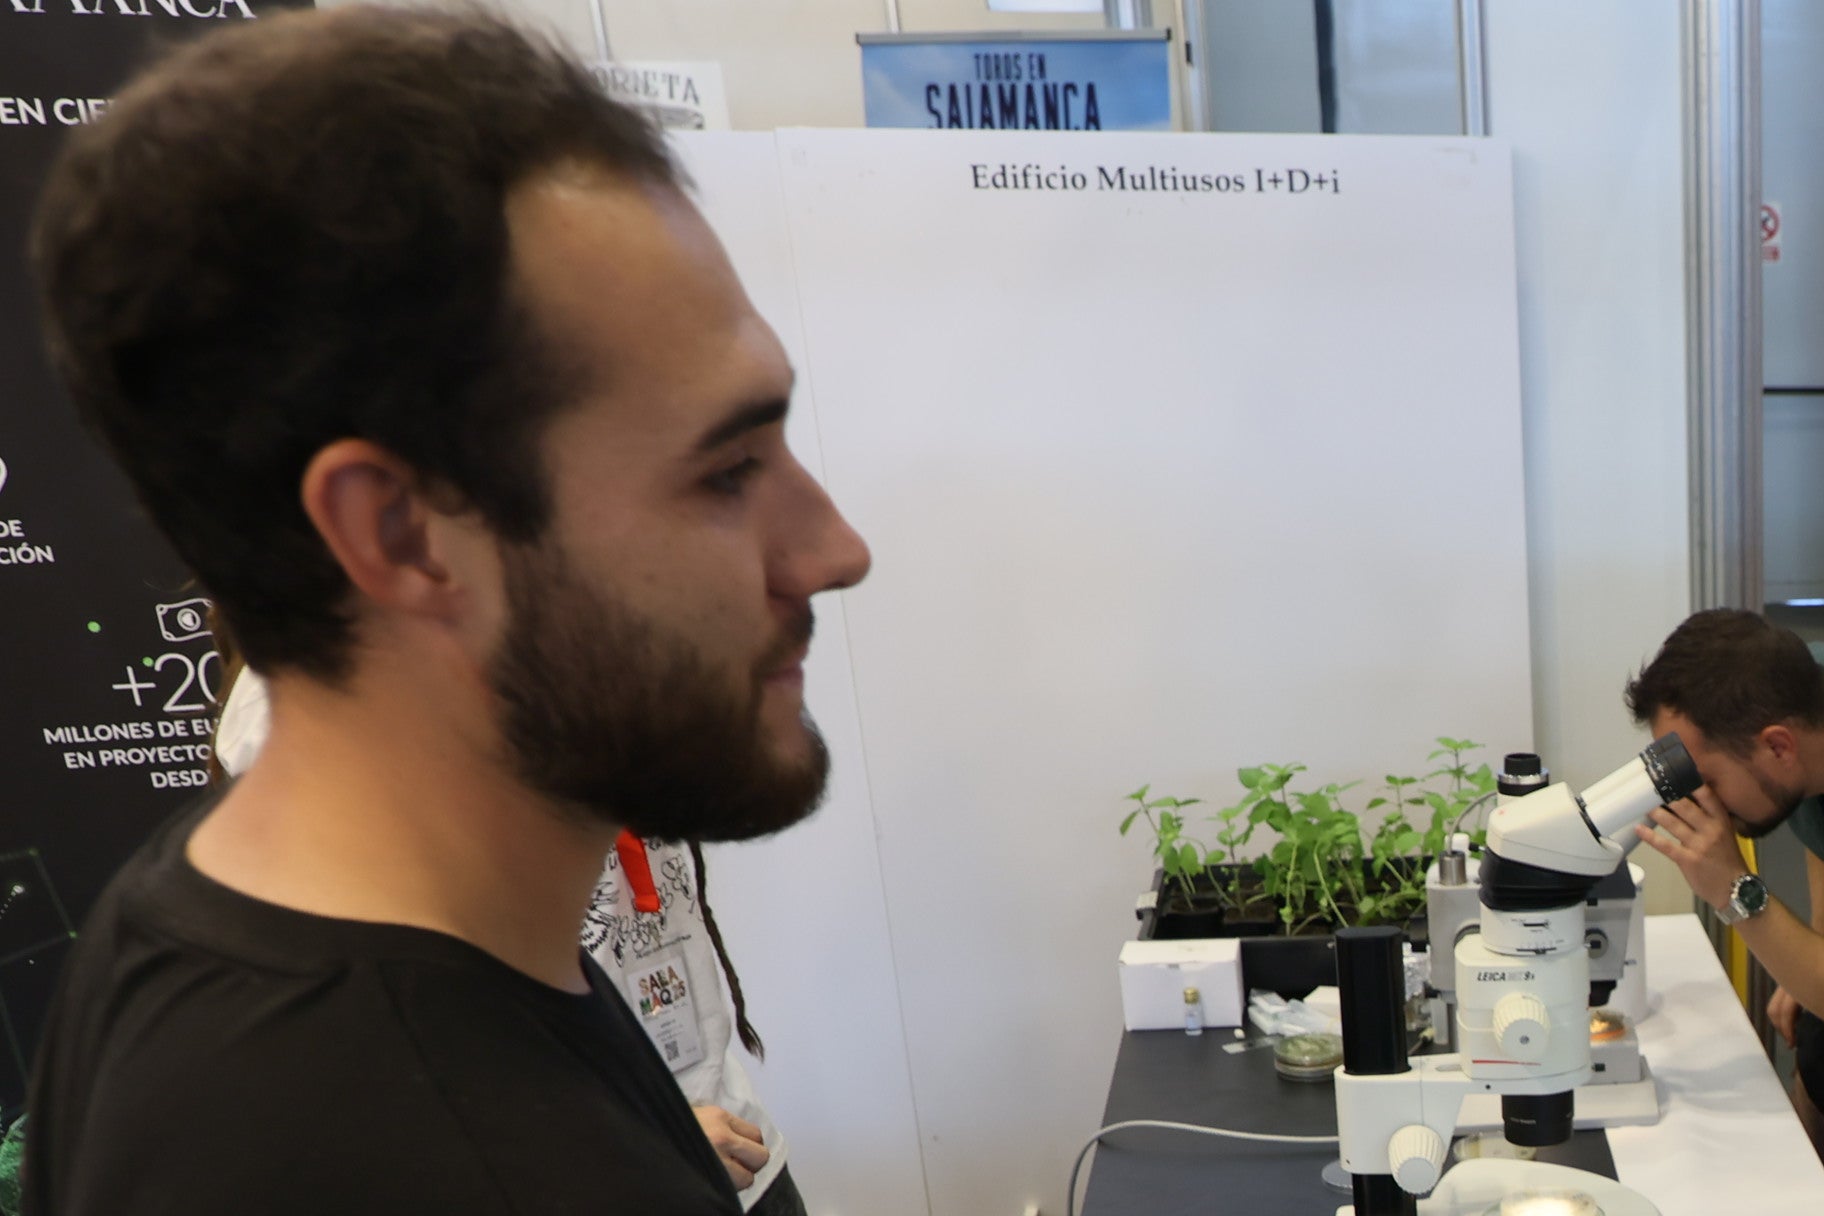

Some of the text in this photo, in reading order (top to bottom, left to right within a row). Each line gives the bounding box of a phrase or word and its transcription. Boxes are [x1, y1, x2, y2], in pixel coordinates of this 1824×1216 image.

[973, 53, 1047, 81] TOROS EN
[0, 96, 47, 125] EN
[970, 164, 1341, 194] Edificio Multiusos I+D+i
[43, 721, 154, 745] MILLONES
[157, 719, 189, 738] DE
[64, 750, 96, 769] EN
[151, 769, 211, 790] DESD
